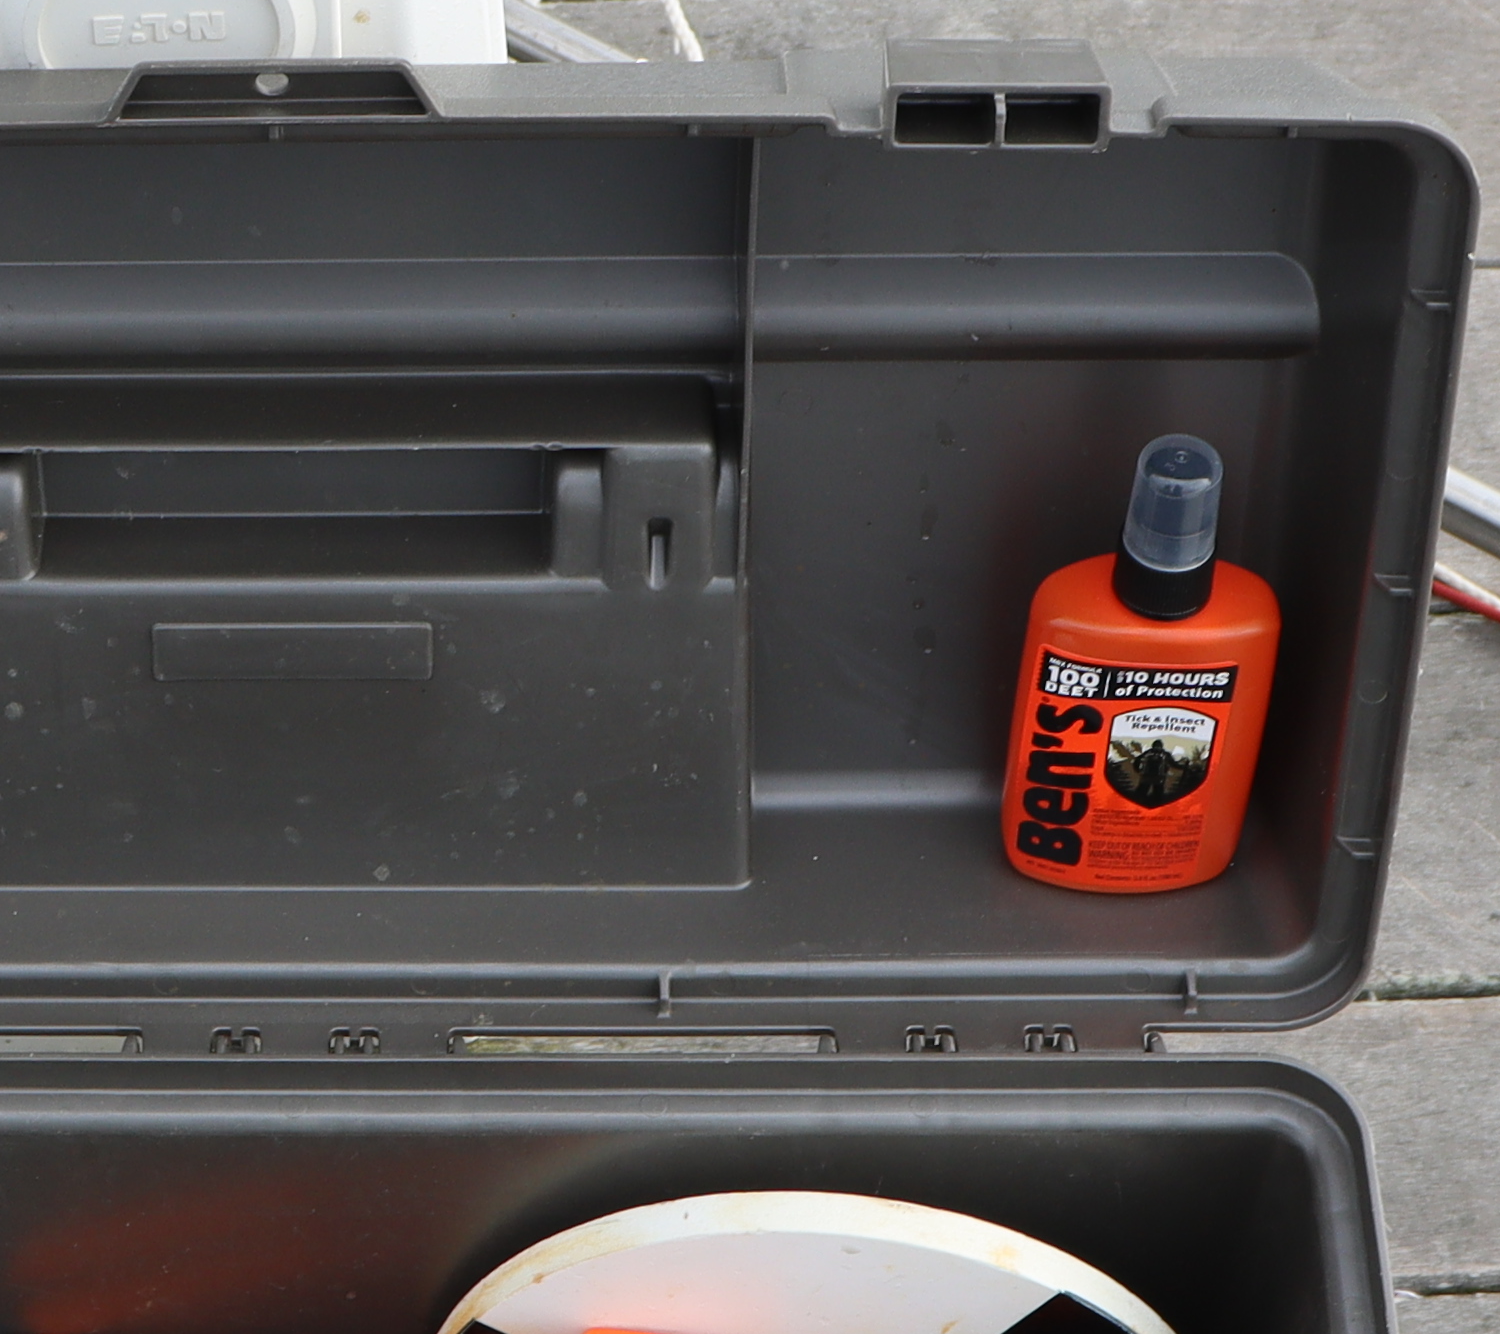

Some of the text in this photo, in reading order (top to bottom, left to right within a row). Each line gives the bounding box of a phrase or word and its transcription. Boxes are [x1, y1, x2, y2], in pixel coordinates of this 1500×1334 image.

[1047, 665, 1101, 689] 100
[1152, 670, 1231, 687] HOURS
[1044, 681, 1099, 699] DEET
[1115, 684, 1225, 700] of Protection
[1124, 713, 1151, 725] Tick
[1164, 714, 1207, 728] Insect
[1131, 721, 1196, 736] Repellent
[1017, 704, 1104, 868] Ben's
